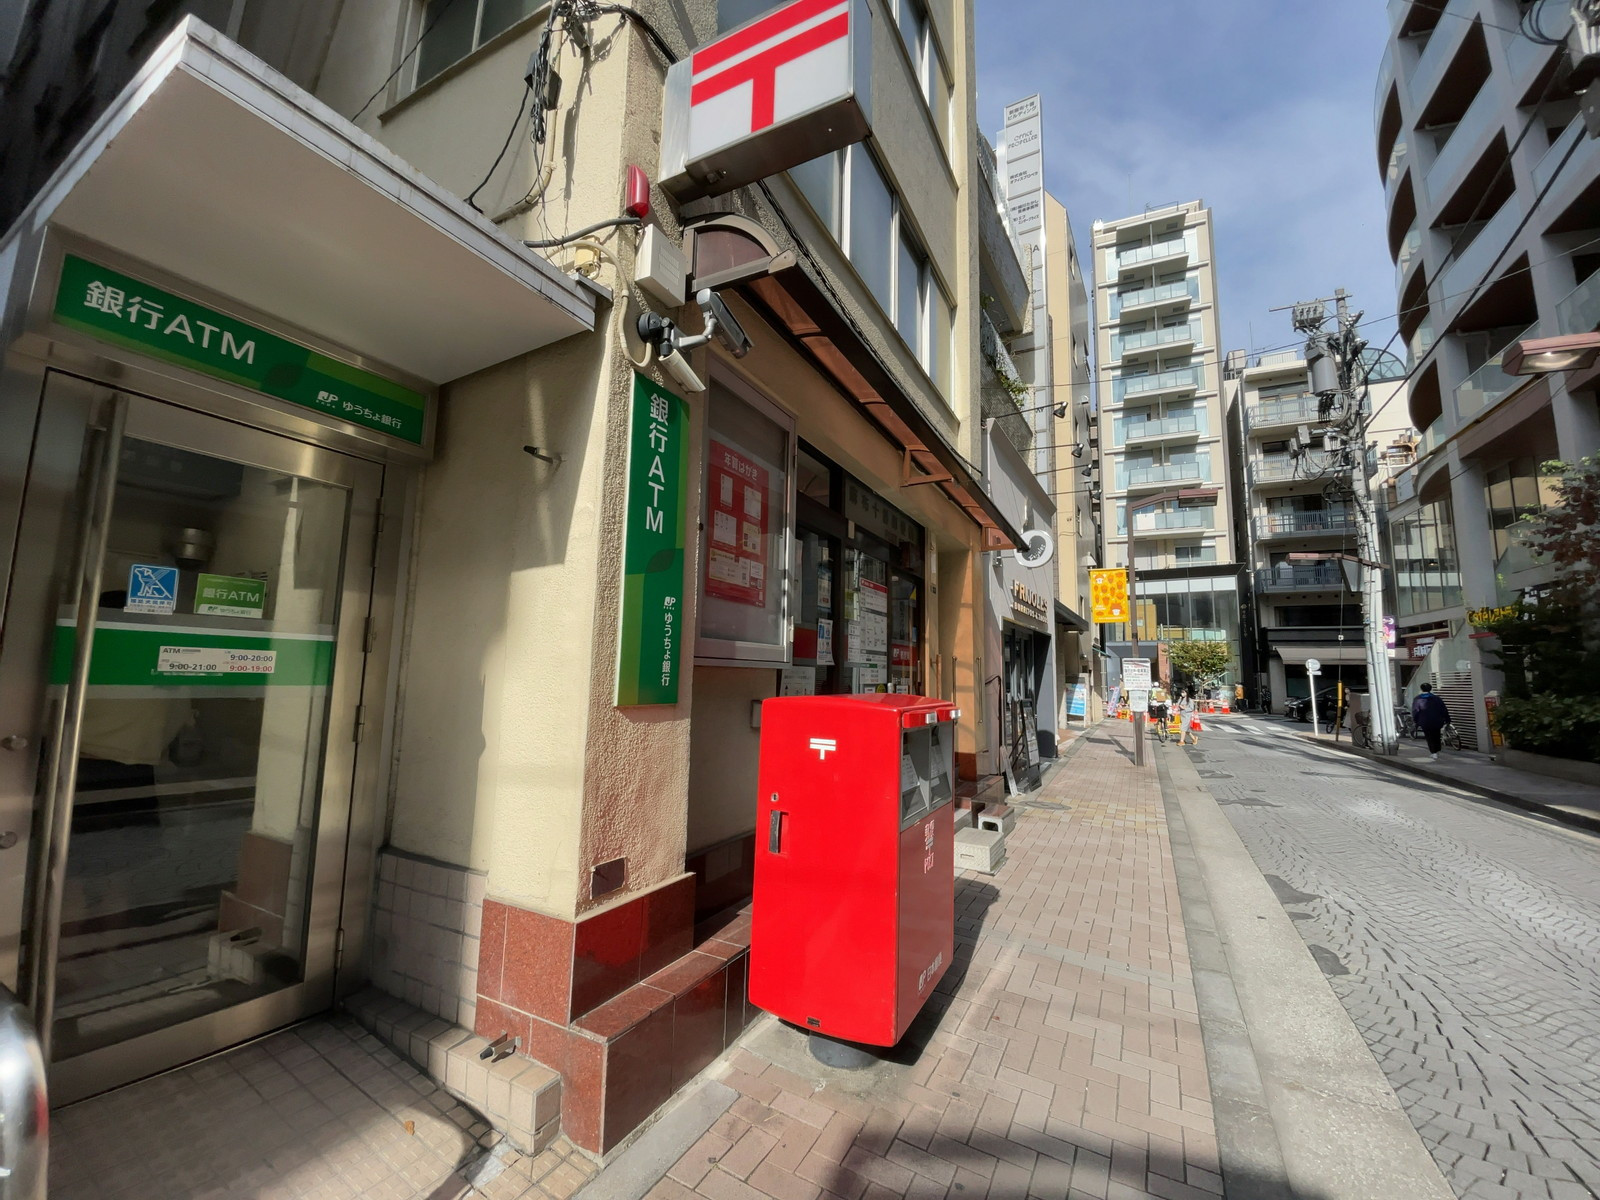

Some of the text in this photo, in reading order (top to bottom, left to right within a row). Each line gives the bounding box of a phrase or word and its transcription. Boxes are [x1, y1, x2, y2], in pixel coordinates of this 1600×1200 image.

[1008, 134, 1038, 148] PROPELLER
[1014, 130, 1033, 141] OFFICE
[83, 280, 256, 365] 銀行ATM
[342, 401, 402, 429] ゆうちょ銀行
[645, 392, 669, 534] 銀行ATM
[724, 451, 758, 481] 年賀はがき
[202, 587, 260, 602] 銀行ATM
[1013, 579, 1049, 613] FRIJOLES
[230, 654, 273, 662] 9:00-20:00
[661, 612, 673, 686] ゆうちょ銀行
[169, 663, 217, 671] 9:00-21:00
